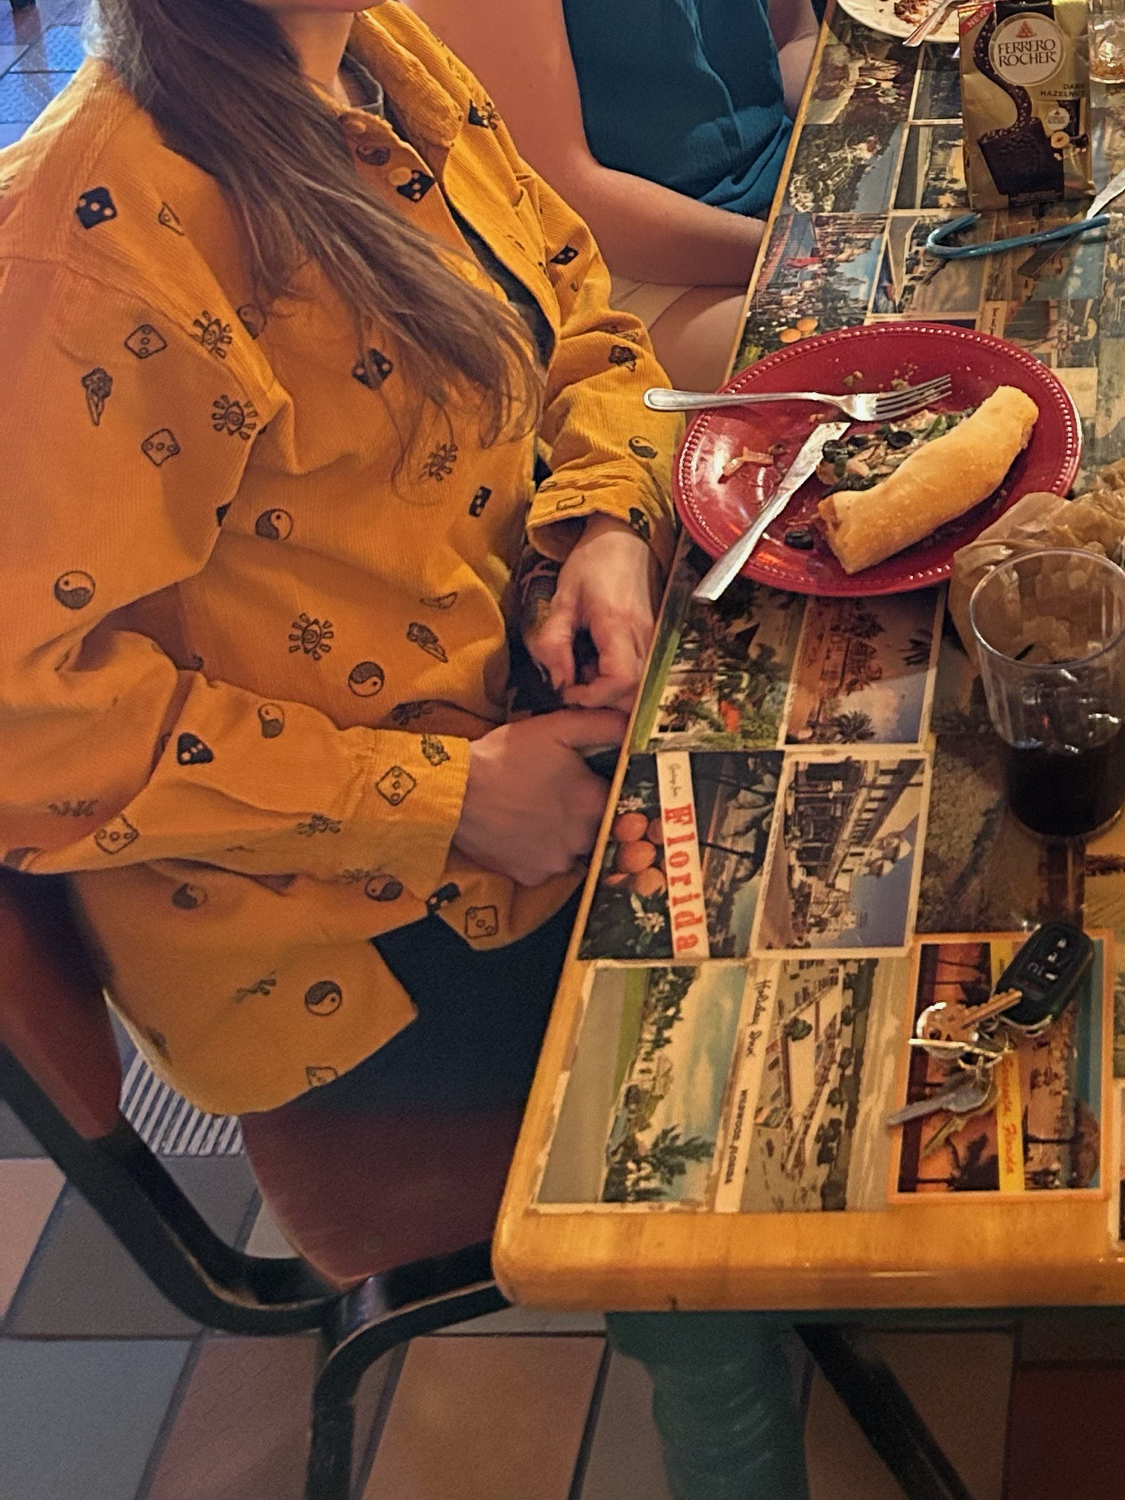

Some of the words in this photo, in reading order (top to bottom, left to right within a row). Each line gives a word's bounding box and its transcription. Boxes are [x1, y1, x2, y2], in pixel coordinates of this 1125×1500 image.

[967, 9, 988, 29] NEW
[999, 39, 1056, 55] FERRERO
[999, 51, 1057, 68] ROCHER
[1040, 90, 1086, 98] HAZELNUT
[1063, 83, 1086, 91] DARK
[665, 803, 704, 953] Florida
